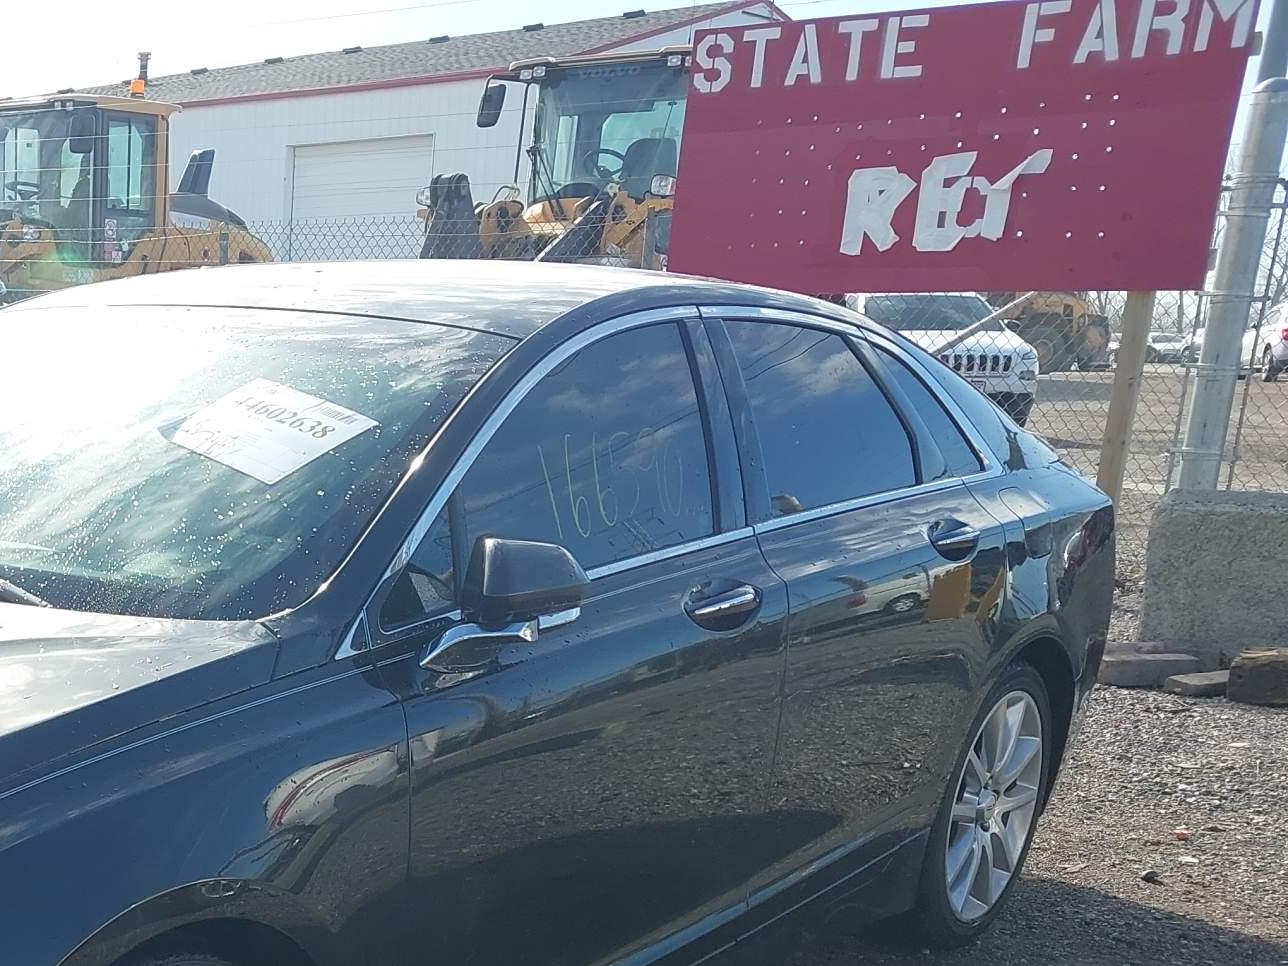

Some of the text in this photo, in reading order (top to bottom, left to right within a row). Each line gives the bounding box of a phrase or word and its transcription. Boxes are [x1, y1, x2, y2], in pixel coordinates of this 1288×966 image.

[694, 0, 1256, 93] STATE FARM
[234, 396, 336, 439] 44602638
